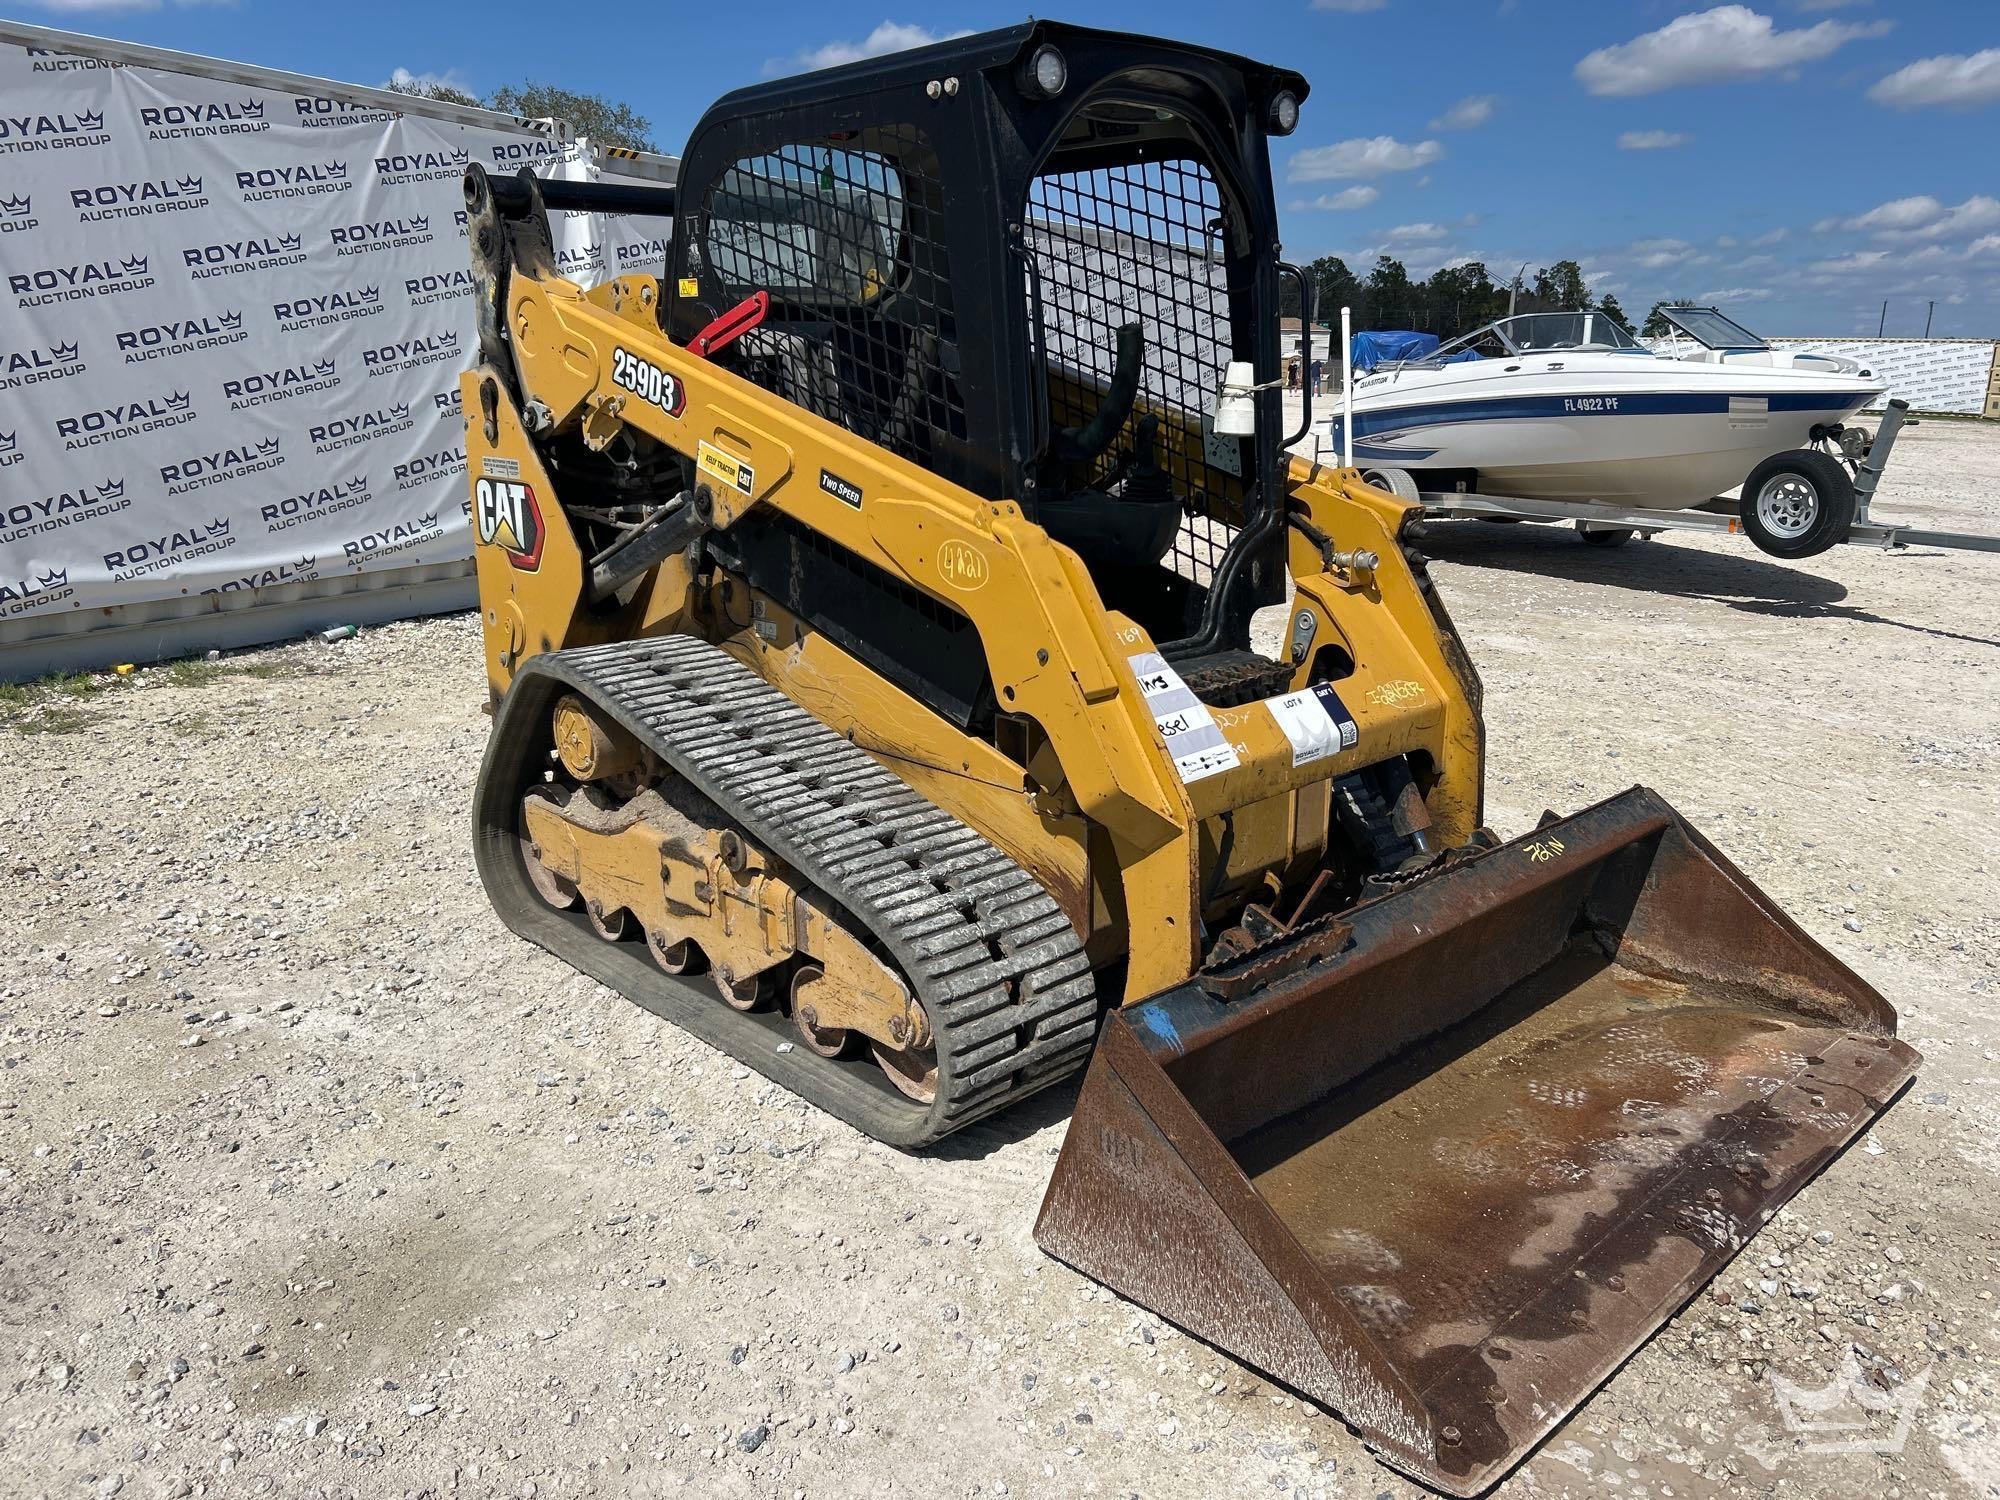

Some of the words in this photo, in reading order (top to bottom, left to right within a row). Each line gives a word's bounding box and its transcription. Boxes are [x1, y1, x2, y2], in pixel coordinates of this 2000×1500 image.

[140, 103, 241, 126] ROYAL
[301, 116, 360, 129] AUCTION
[52, 134, 111, 150] GROUP
[149, 126, 217, 140] AUCTION
[220, 122, 270, 136] GROUP
[374, 152, 452, 174] ROYAL
[493, 141, 561, 161] ROYAL
[497, 160, 542, 172] AUCTION
[544, 154, 580, 167] GROUP
[236, 164, 327, 190] ROYAL
[380, 172, 433, 186] AUCTION
[435, 168, 467, 182] GROU
[70, 181, 180, 208] ROYAL
[243, 187, 305, 202] AUCTION
[308, 182, 352, 195] GROUP
[80, 204, 152, 223] AUCTION
[155, 198, 209, 214] GROUP
[330, 219, 410, 245] ROYAL
[337, 242, 391, 257] AUCTION
[392, 233, 434, 247] GROUP
[183, 238, 280, 267] ROYAL
[191, 261, 256, 280] AUCTION
[260, 253, 307, 270] GROUP
[620, 257, 658, 271] AUCTION
[8, 261, 123, 294] ROYAL
[566, 260, 605, 274] GROUP
[18, 287, 95, 308] AUCTION
[98, 278, 155, 296] GROUP
[273, 291, 359, 321] ROYAL
[411, 289, 460, 307] AUCTION
[280, 314, 339, 333] AUCTION
[341, 304, 384, 321] GROUP
[116, 317, 221, 351] ROYAL
[124, 344, 194, 364] AUCTION
[197, 331, 248, 350] GROUP
[362, 336, 440, 366] ROYAL
[368, 358, 421, 378] AUCTION
[422, 348, 462, 364] GROUP
[24, 363, 86, 384] GROUP
[223, 365, 315, 398] ROYAL
[613, 348, 674, 410] 259D3
[230, 389, 293, 411] AUCTION
[295, 377, 341, 396] GROUP
[1564, 399, 1576, 411] FL
[1577, 398, 1603, 411] 4922
[1605, 398, 1618, 410] PF
[56, 400, 166, 437] ROYAL
[65, 425, 139, 451] AUCTION
[142, 411, 197, 432] GROUP
[309, 410, 392, 443] ROYAL
[316, 434, 372, 455] AUCTION
[373, 420, 414, 439] GROUP
[160, 445, 258, 483] ROYAL
[168, 467, 234, 496] AUCTION
[236, 456, 285, 477] GROUP
[717, 461, 736, 477] TRACTOR
[739, 470, 751, 487] CAT
[398, 468, 448, 491] AUCTION
[823, 474, 837, 491] TWO
[838, 483, 859, 503] SPEED
[73, 499, 131, 522] GROUP
[261, 484, 348, 521] ROYAL
[268, 508, 327, 533] AUCTION
[329, 494, 372, 515] GROUP
[477, 479, 525, 550] CAT
[103, 529, 207, 571] ROYAL
[343, 520, 421, 558] ROYAL
[347, 543, 402, 567] AUCTION
[404, 529, 444, 548] GROUP
[114, 557, 182, 583] AUCTION
[184, 536, 236, 560] GROUP
[10, 588, 74, 614] GROUP
[1283, 699, 1297, 709] LOT
[1316, 689, 1328, 698] DAY
